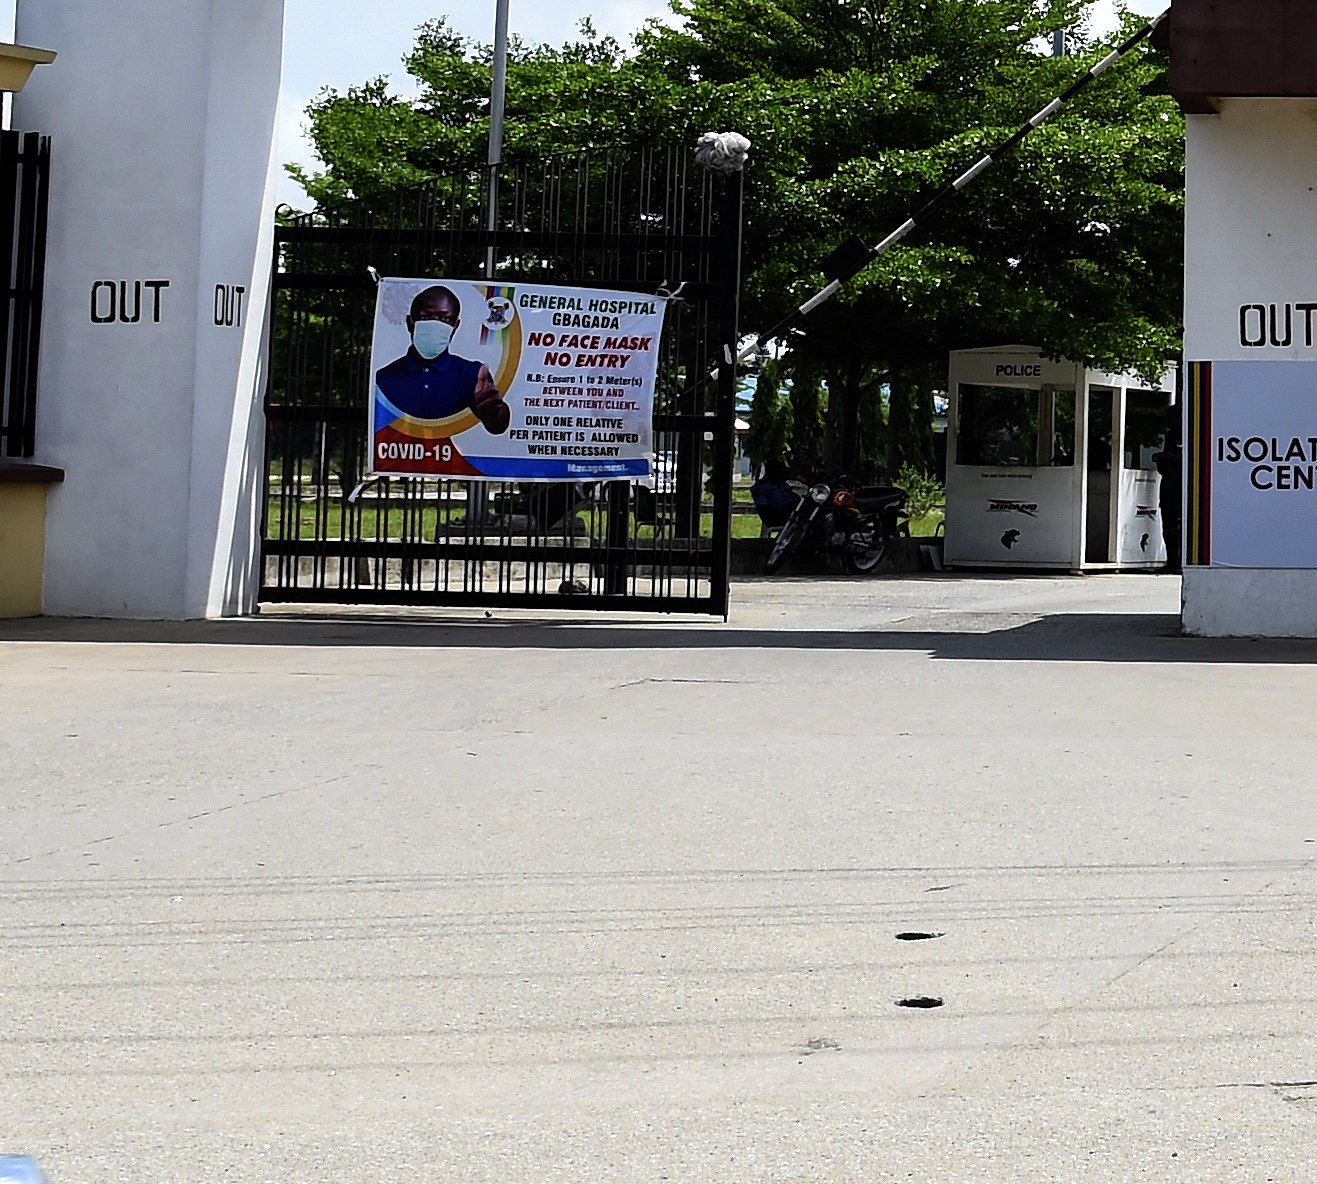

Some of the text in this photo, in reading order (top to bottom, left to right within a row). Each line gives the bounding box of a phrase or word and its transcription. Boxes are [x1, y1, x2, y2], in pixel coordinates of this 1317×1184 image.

[90, 279, 171, 324] OUT
[213, 283, 246, 327] OUT
[519, 293, 657, 315] GENERAL HOSPITAL
[552, 312, 620, 330] GBAGADA
[527, 332, 653, 351] NO FACE MASK
[543, 352, 632, 368] NO ENTRY
[995, 365, 1042, 377] POLICE
[578, 375, 584, 384] 1
[586, 376, 596, 385] to
[597, 376, 604, 385] 2
[605, 376, 643, 387] Meter(s)
[542, 386, 625, 398] BETWEEN YOU AND
[524, 397, 541, 407] THE
[543, 399, 565, 408] NEXT
[525, 415, 624, 429] ONLY ONE RELATIVE
[509, 429, 639, 444] PER PATIENT IS ALLOWED
[377, 442, 452, 462] COVID-19
[527, 444, 620, 457] WHEN NECESSARY
